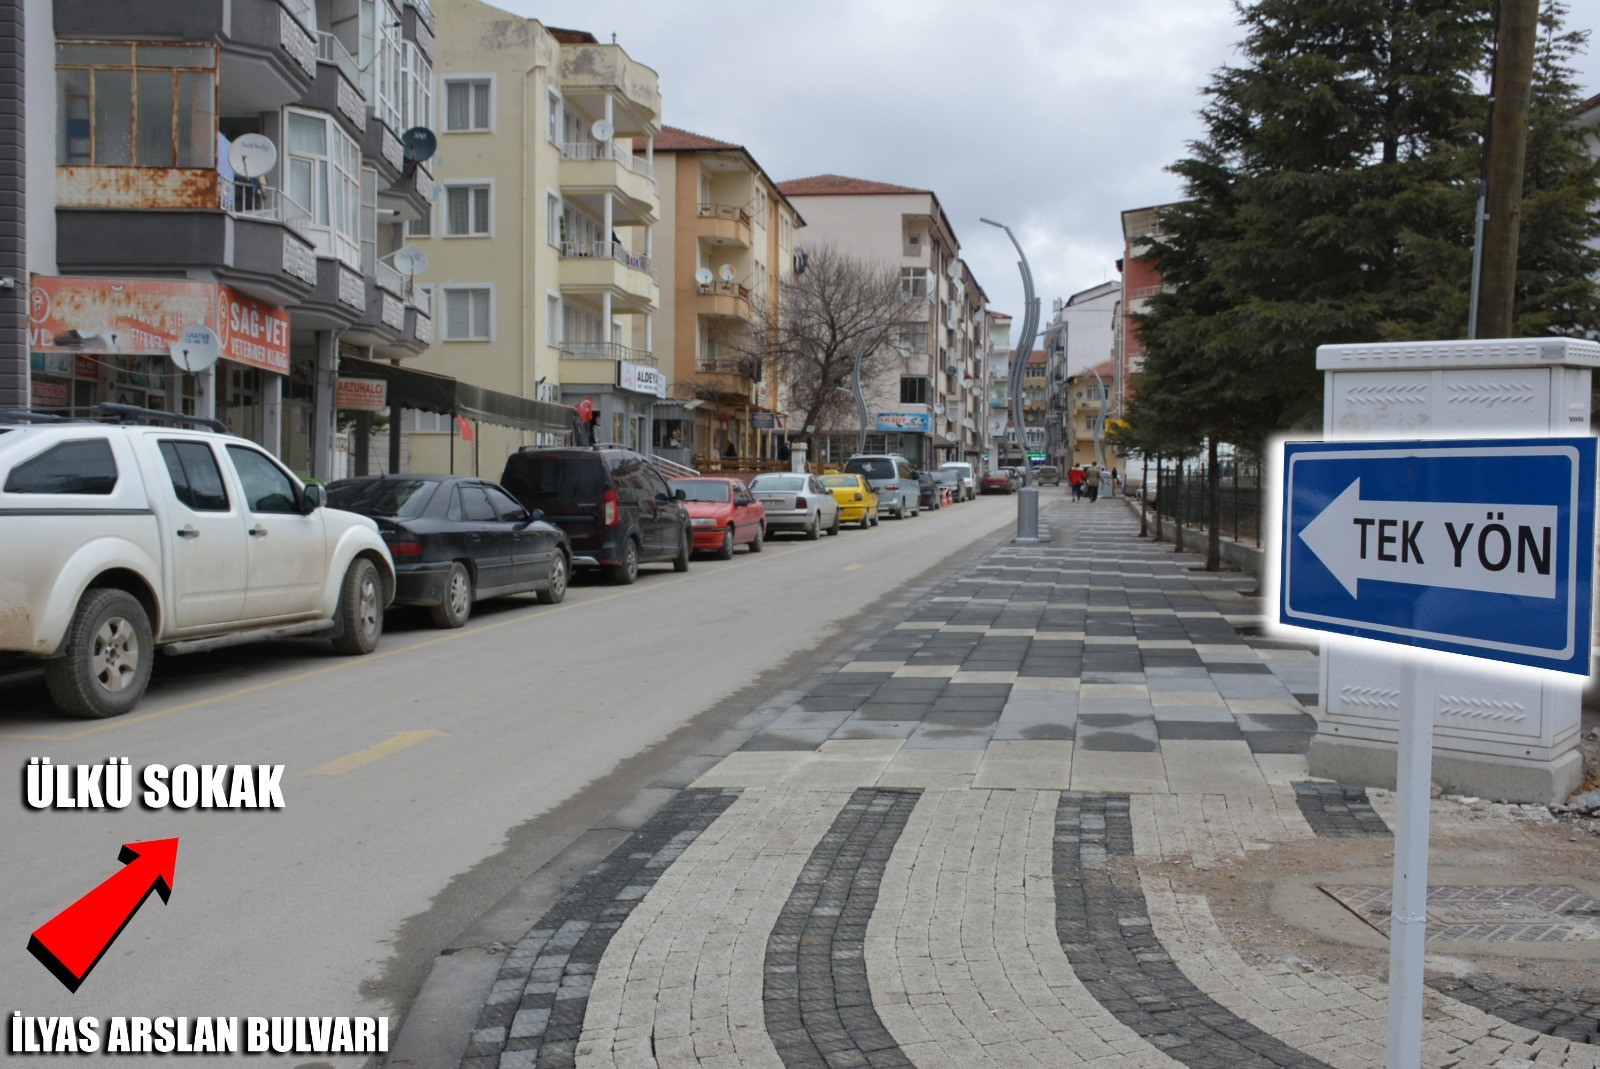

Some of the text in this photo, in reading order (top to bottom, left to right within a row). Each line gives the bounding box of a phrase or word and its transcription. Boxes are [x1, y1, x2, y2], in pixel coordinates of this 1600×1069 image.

[230, 301, 288, 348] SAĞ-VET
[879, 416, 907, 425] AKSOY
[1353, 511, 1552, 576] TEK YÖN
